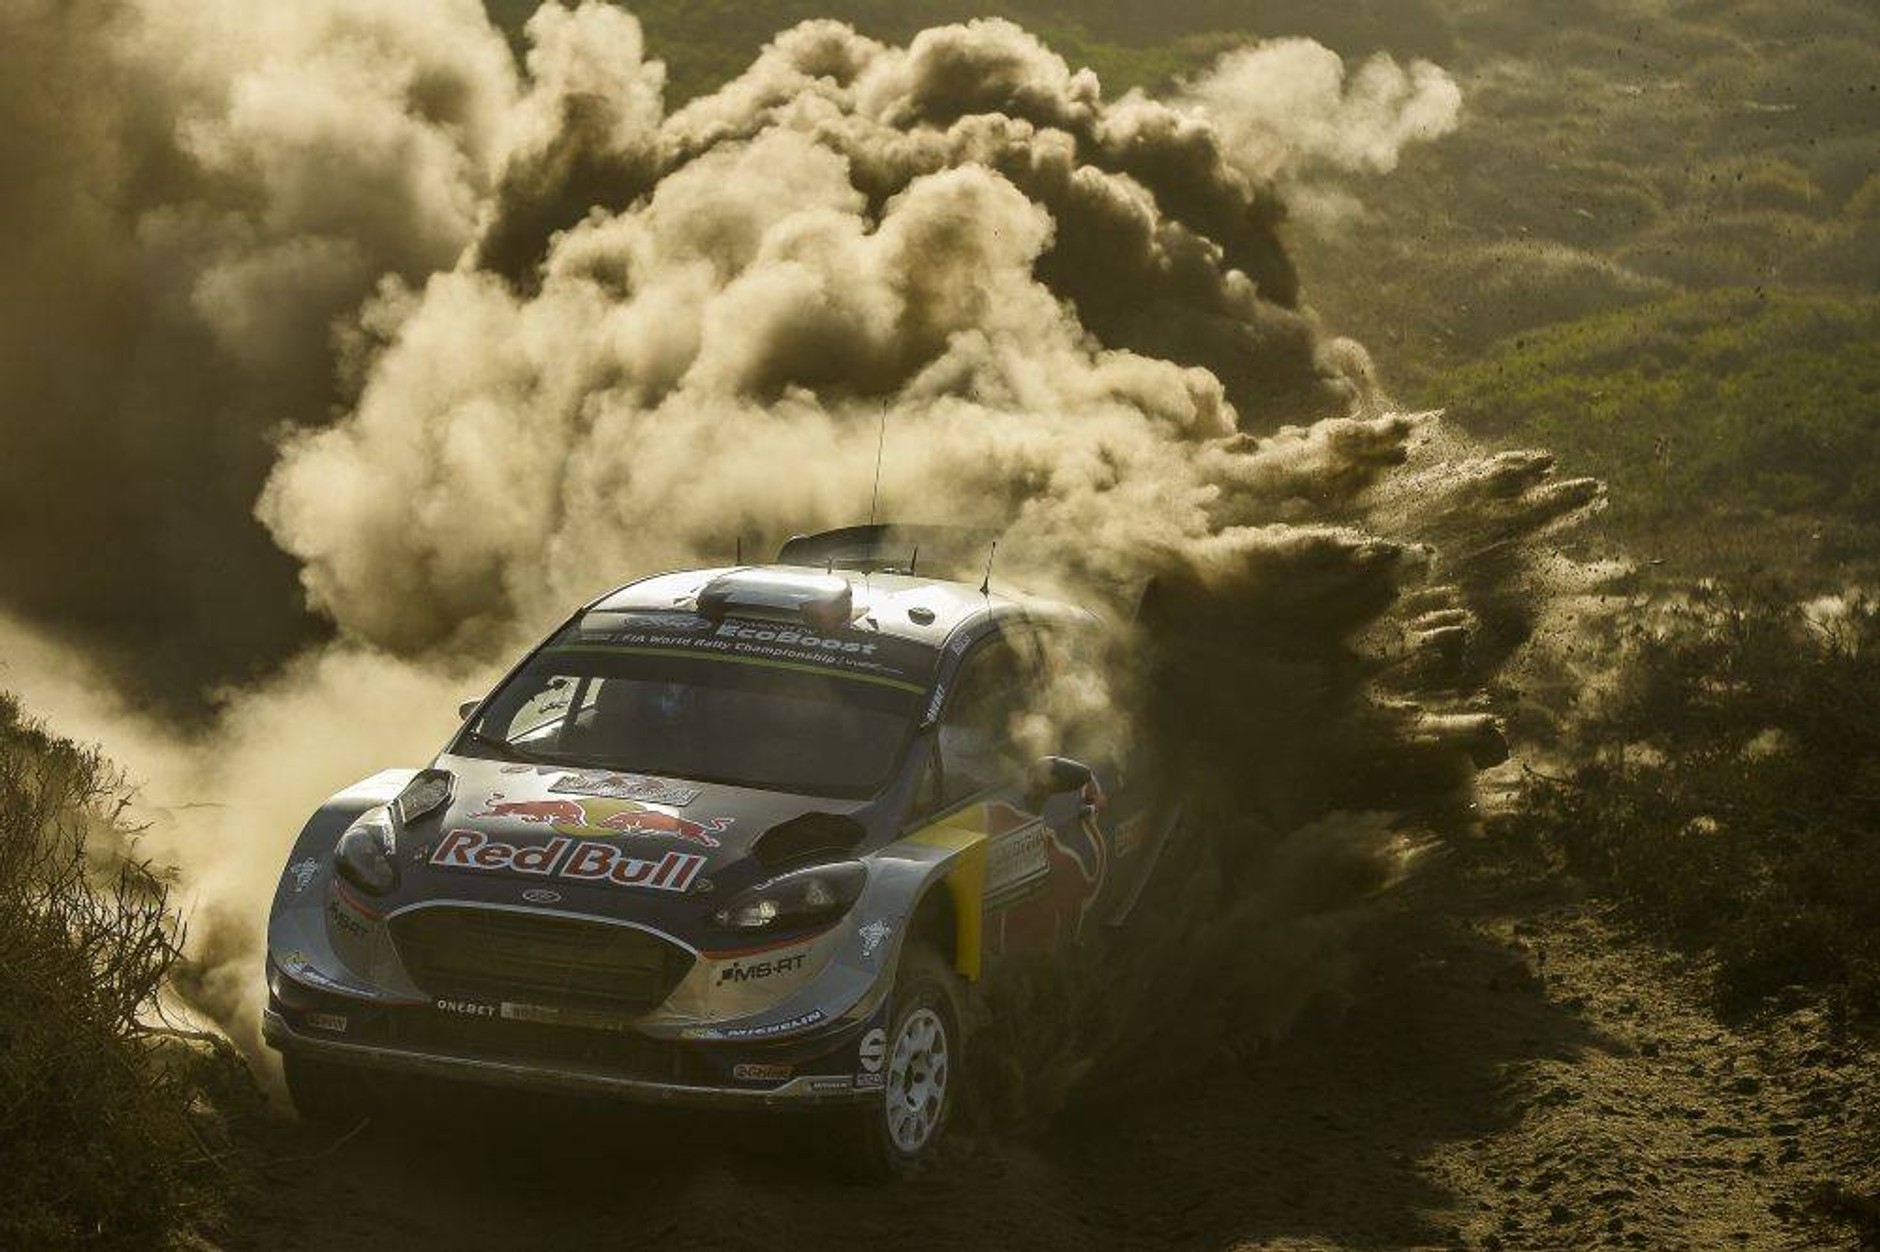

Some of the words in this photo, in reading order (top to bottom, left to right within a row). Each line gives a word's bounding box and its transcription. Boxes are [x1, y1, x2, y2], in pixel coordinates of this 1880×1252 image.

[622, 633, 647, 643] FIA
[650, 635, 690, 647] World
[694, 638, 730, 650] Rally
[734, 641, 836, 664] Championship
[715, 623, 877, 655] EcoBoost
[430, 829, 572, 875] Red
[560, 842, 707, 892] Bull
[437, 1000, 496, 1017] ONEBET
